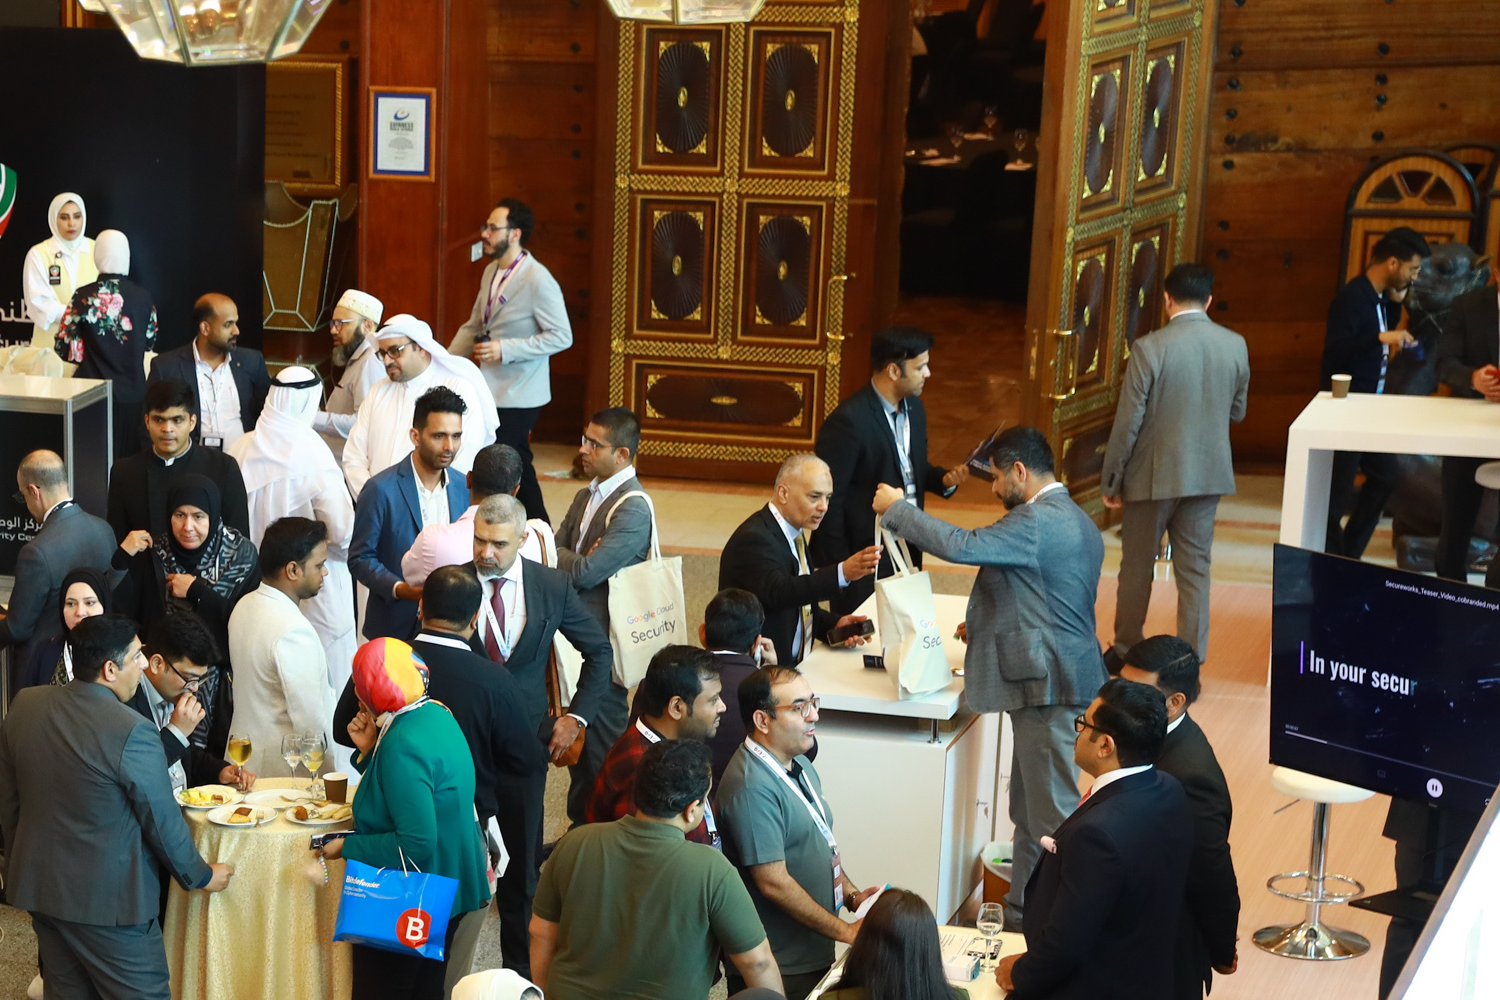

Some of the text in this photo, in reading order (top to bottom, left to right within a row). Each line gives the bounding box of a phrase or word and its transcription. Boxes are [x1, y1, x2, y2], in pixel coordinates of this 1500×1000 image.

[627, 610, 655, 624] Google
[631, 620, 676, 644] Security
[1310, 650, 1325, 675] In
[1330, 660, 1366, 684] your
[346, 875, 380, 888] Bitdefender
[406, 916, 425, 940] B
